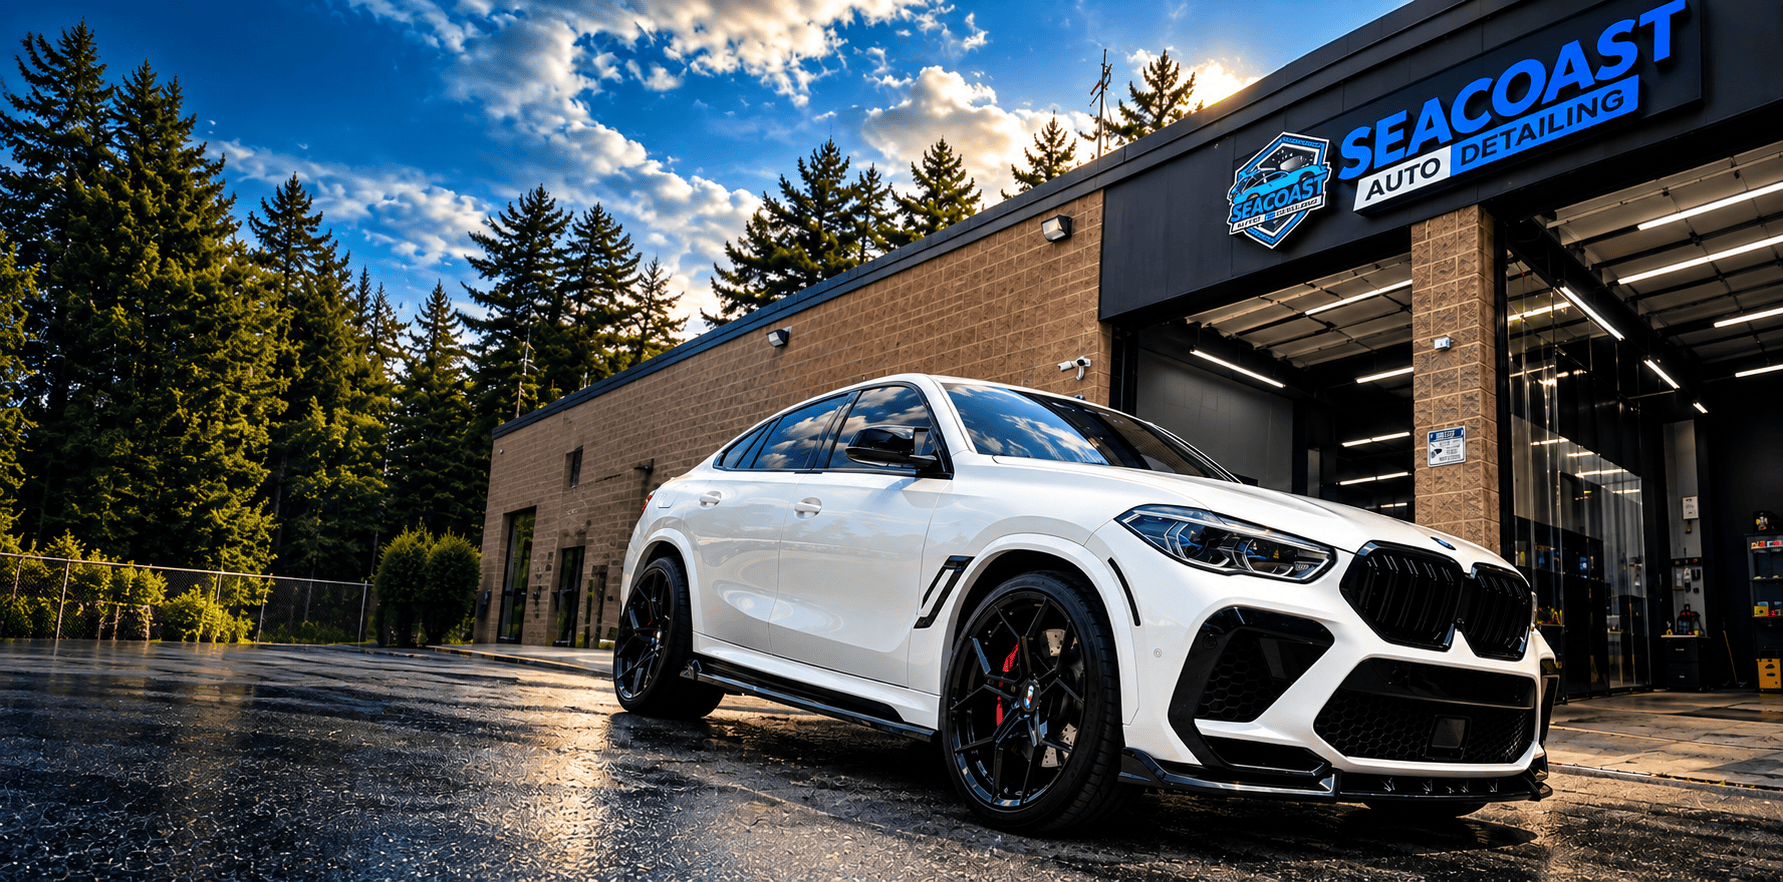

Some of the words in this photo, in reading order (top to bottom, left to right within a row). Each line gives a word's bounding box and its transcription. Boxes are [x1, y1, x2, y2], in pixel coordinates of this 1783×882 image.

[1338, 0, 1686, 180] SEACOAST
[1365, 157, 1441, 201] AUTO
[1461, 89, 1624, 165] DETAILING
[1230, 172, 1328, 223] SEACOAST
